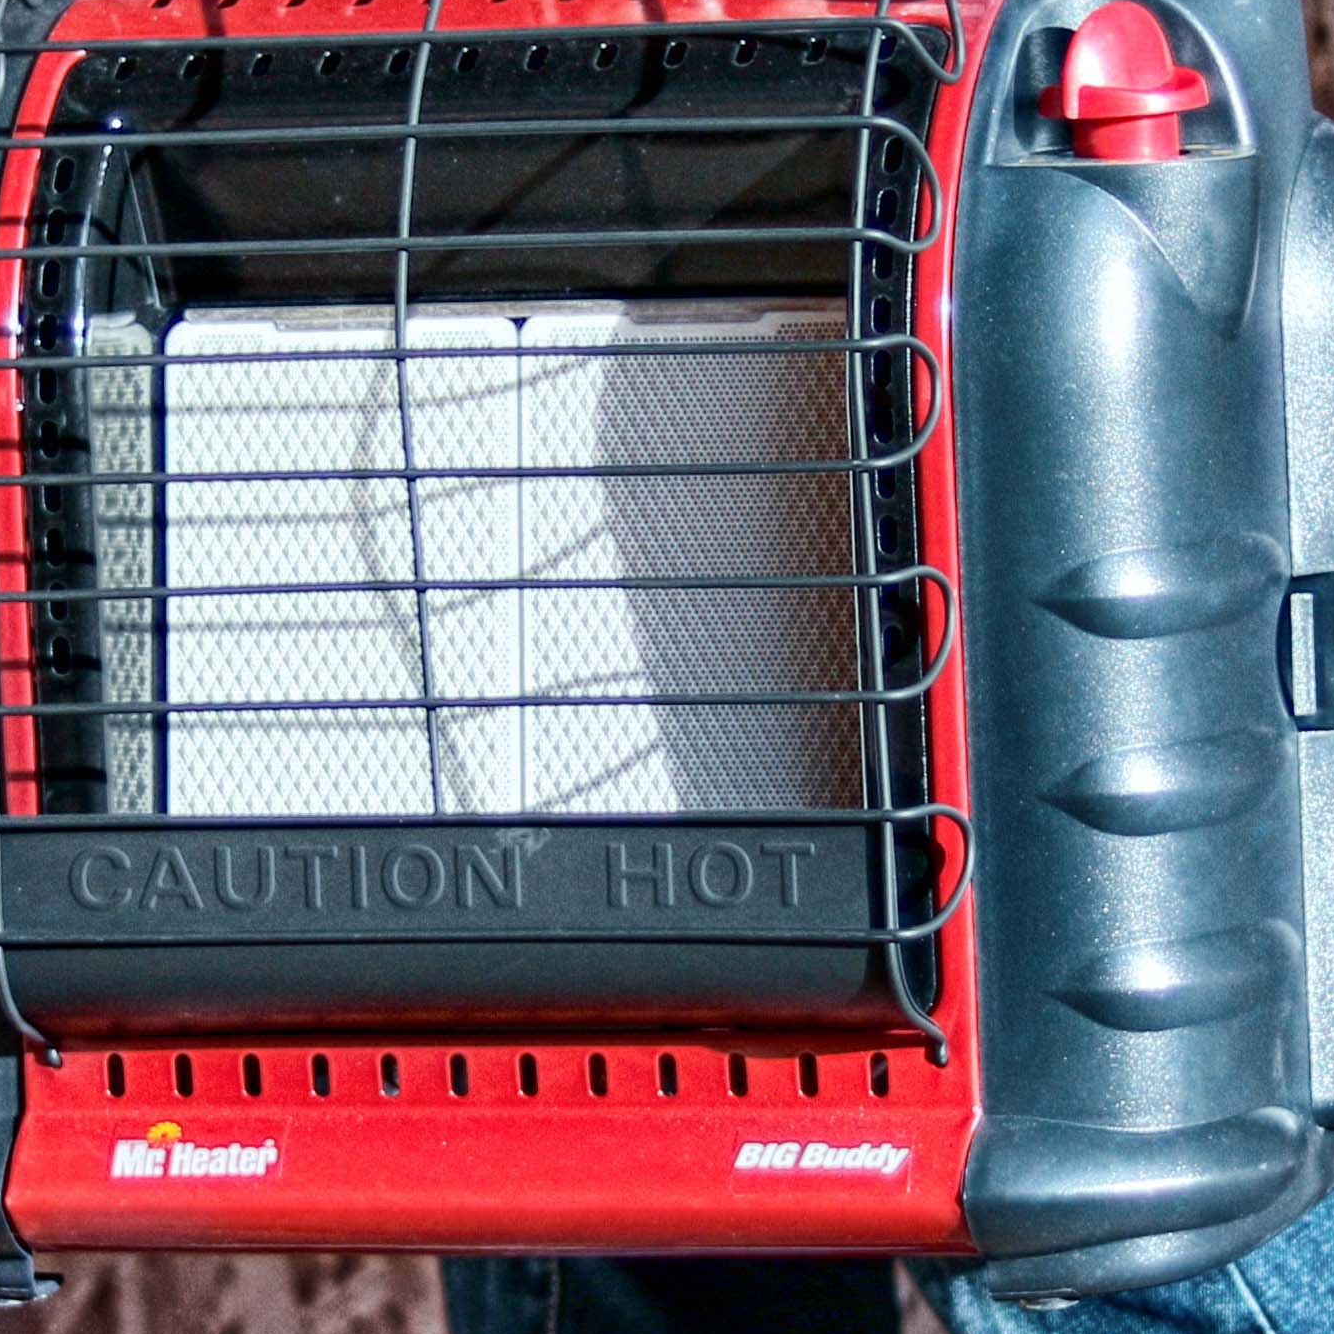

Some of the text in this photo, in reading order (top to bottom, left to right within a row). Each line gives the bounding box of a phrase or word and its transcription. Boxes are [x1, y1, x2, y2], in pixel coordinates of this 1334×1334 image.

[69, 841, 817, 910] CAUTION HOT
[111, 1139, 278, 1178] Mr. Heater
[734, 1141, 910, 1175] BIG Buddy
